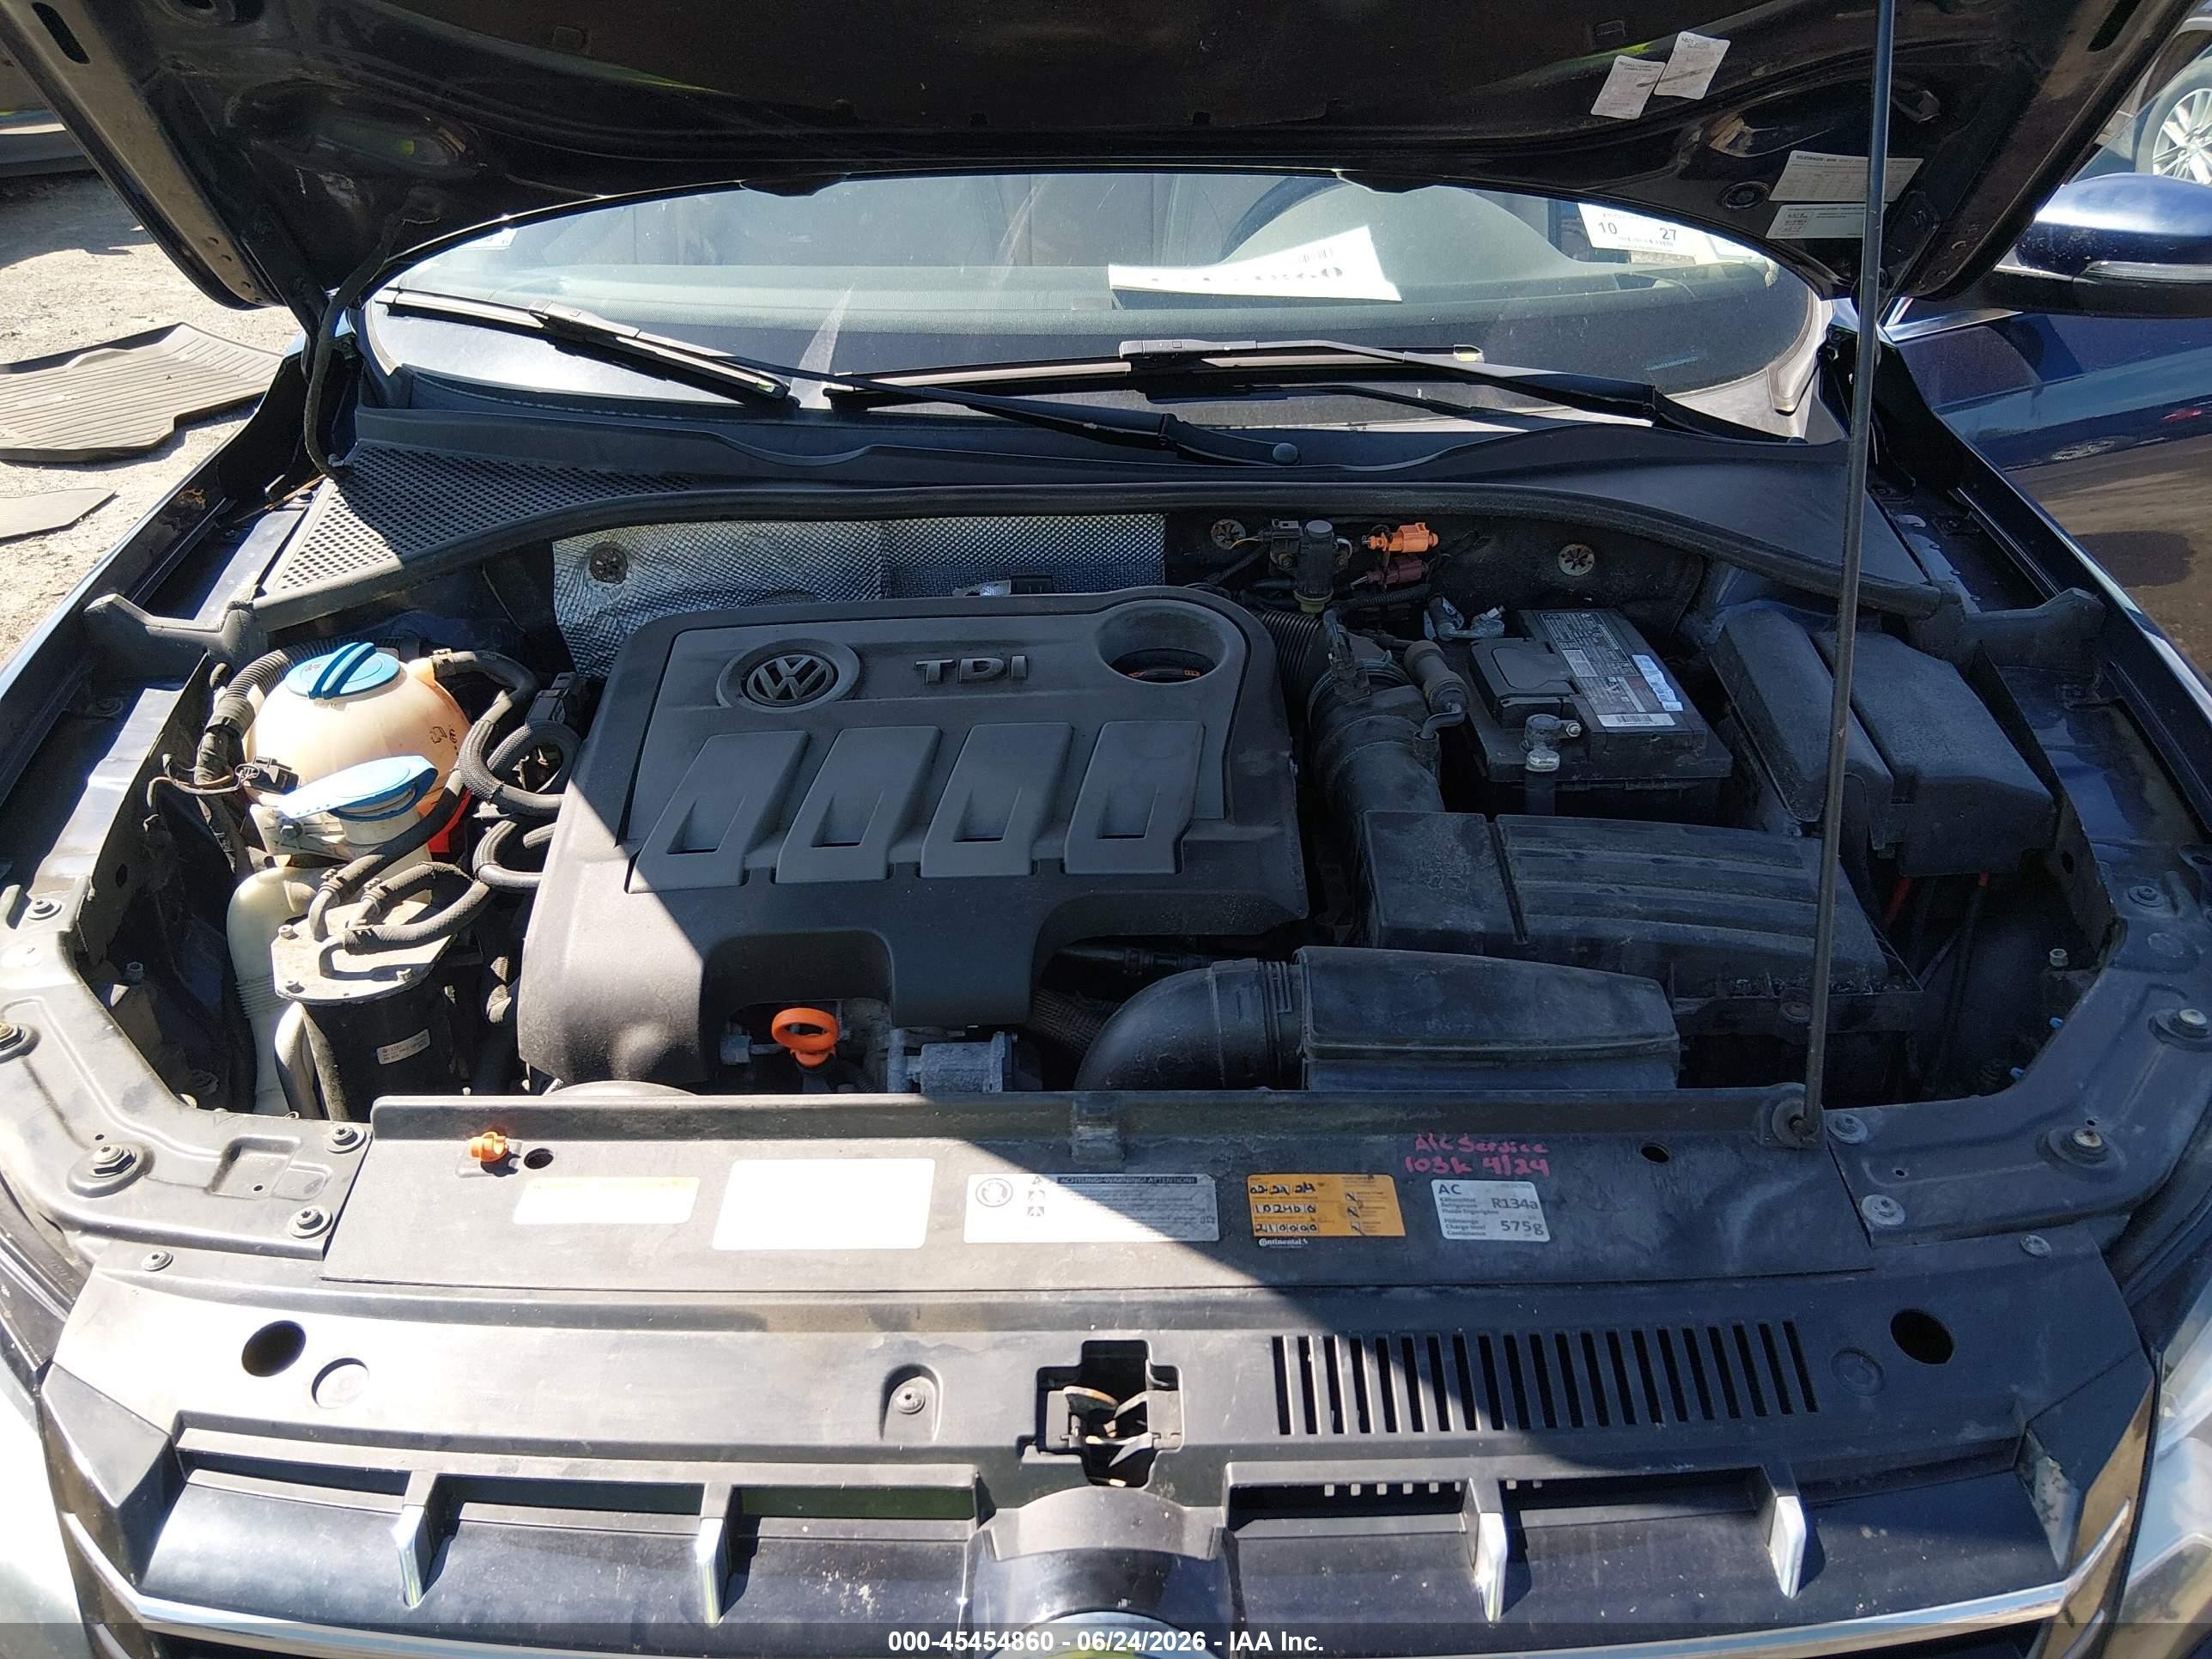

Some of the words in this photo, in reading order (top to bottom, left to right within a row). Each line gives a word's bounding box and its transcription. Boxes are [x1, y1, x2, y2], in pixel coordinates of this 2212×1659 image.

[1598, 222, 1618, 234] 10
[1659, 228, 1677, 240] 27
[915, 655, 1029, 685] TDI
[1438, 1183, 1462, 1194] AC
[1491, 1197, 1539, 1210] R134a
[1500, 1220, 1544, 1236] 575g
[1258, 1237, 1303, 1247] Continental
